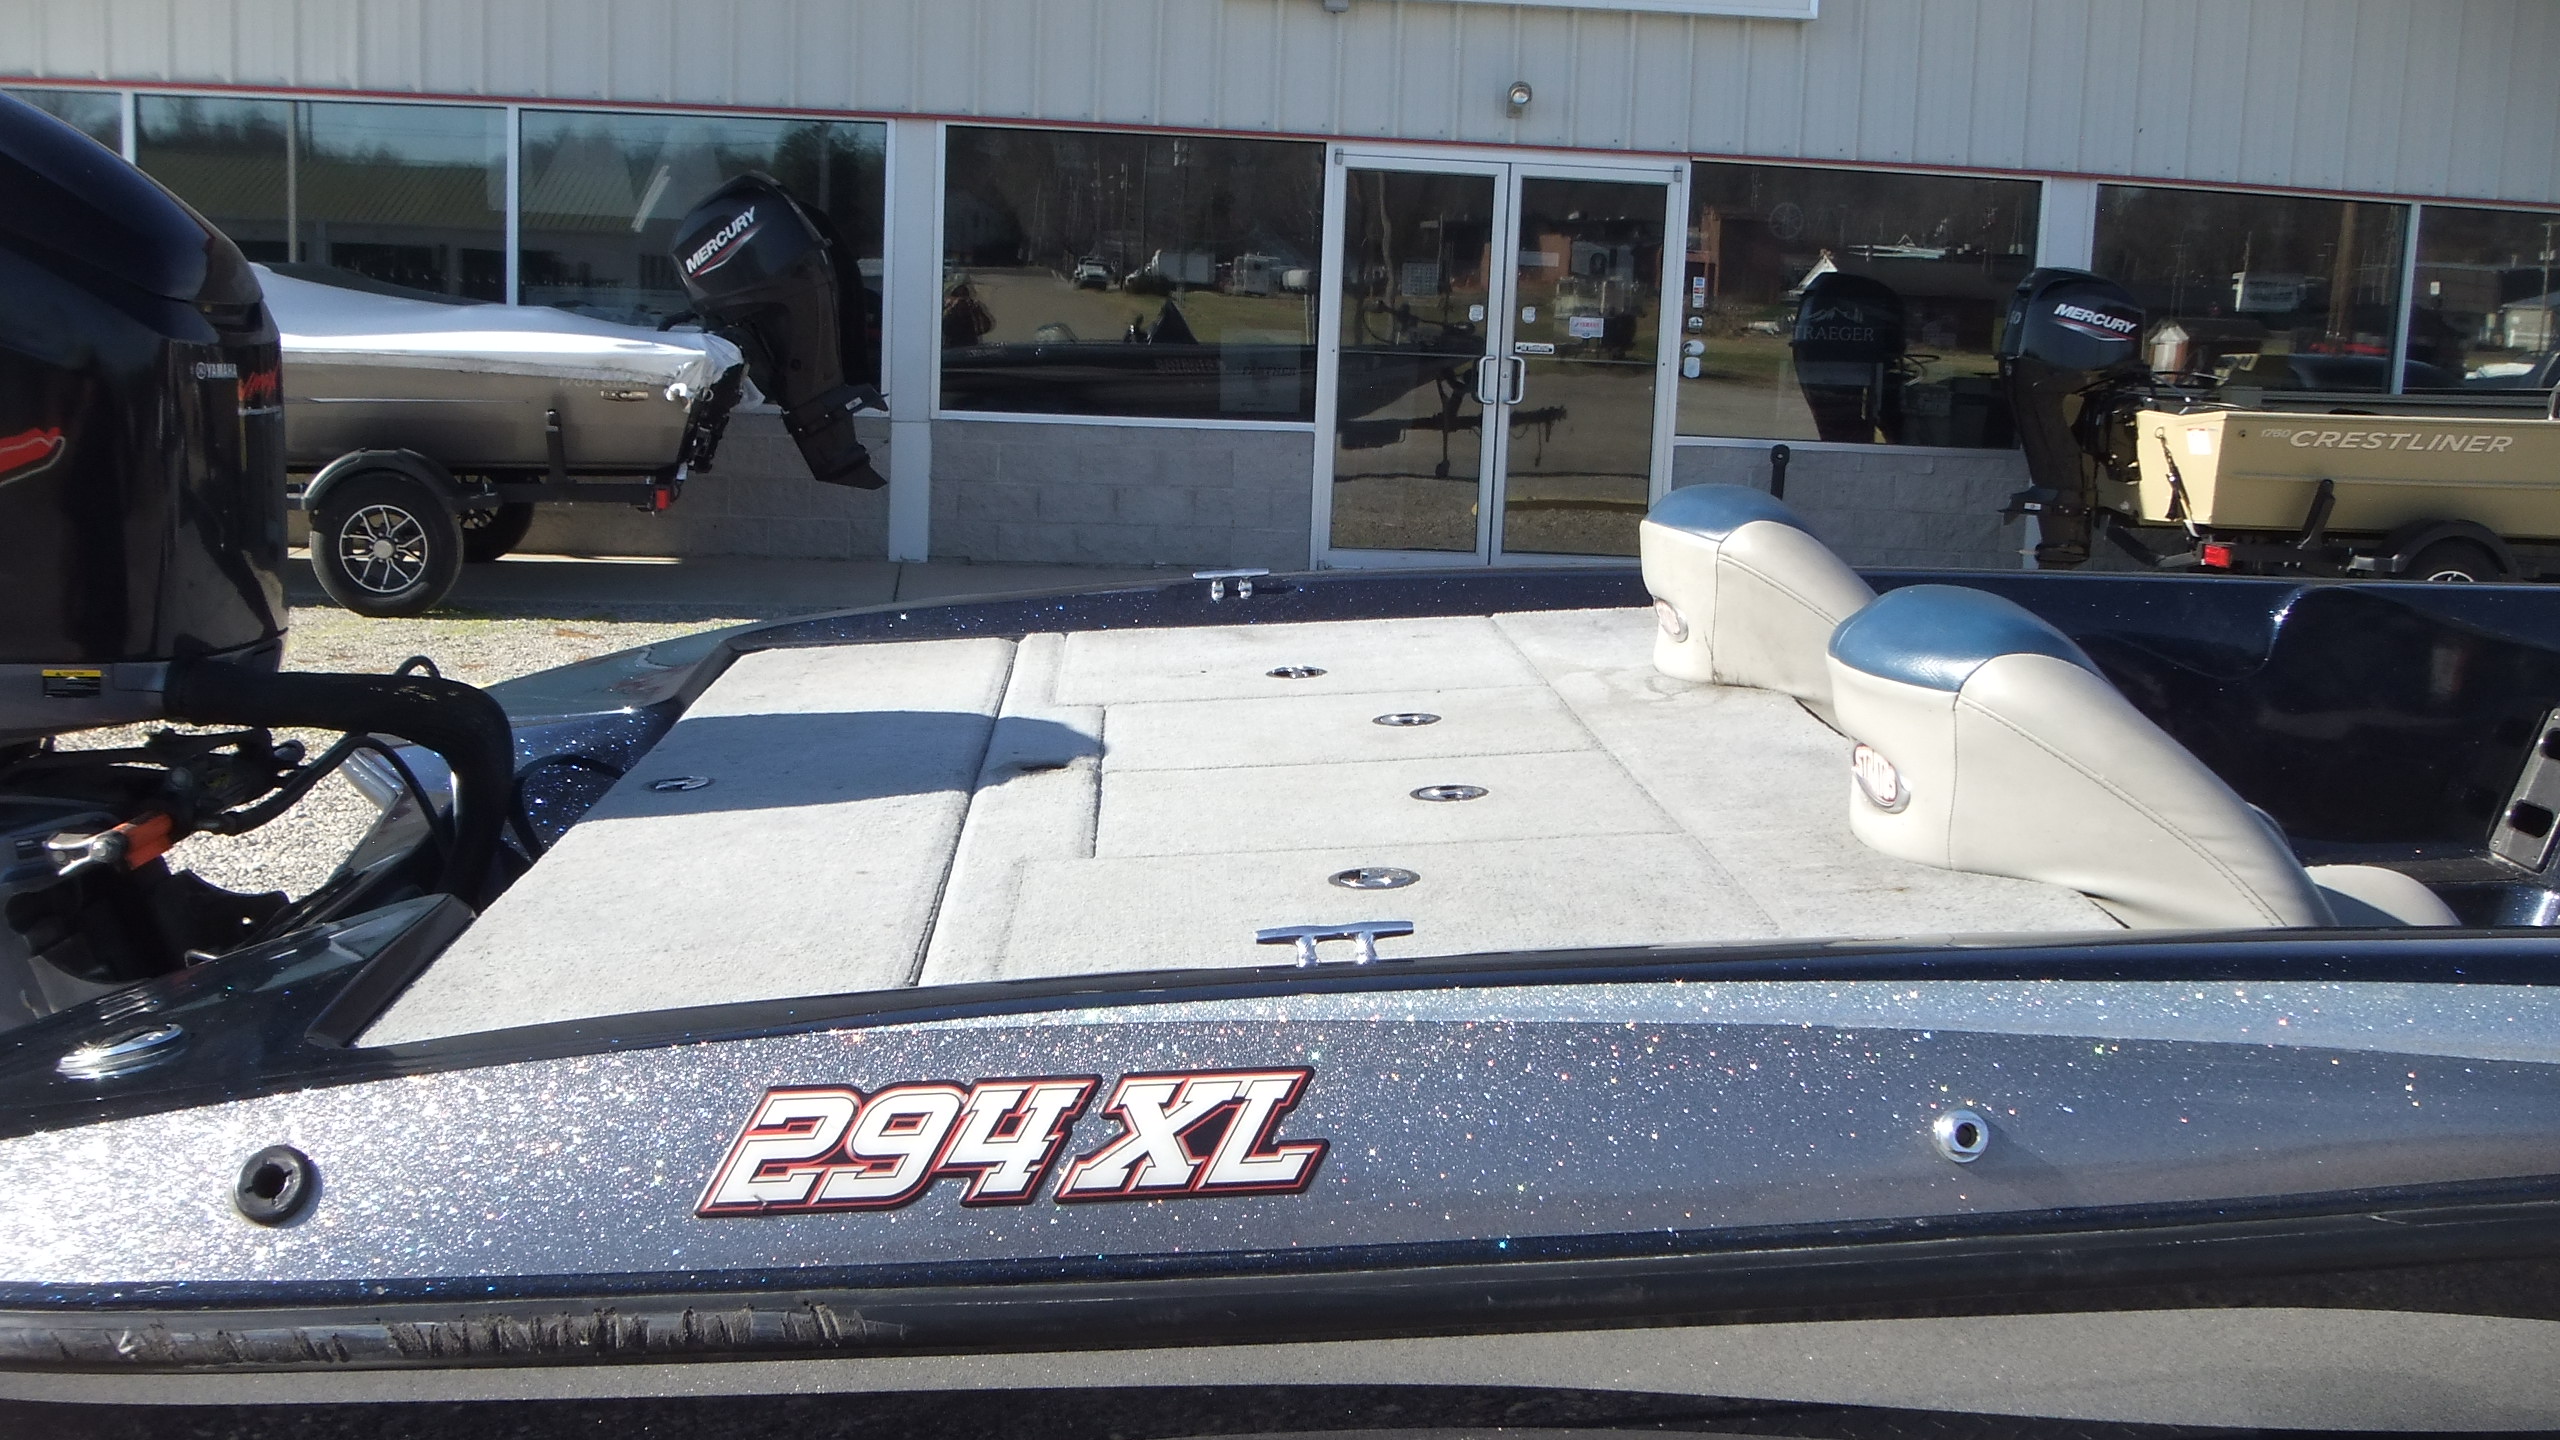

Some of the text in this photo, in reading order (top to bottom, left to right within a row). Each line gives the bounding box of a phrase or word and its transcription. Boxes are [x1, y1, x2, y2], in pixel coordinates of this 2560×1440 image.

[685, 205, 755, 274] MERCURY
[2054, 303, 2137, 334] MERCURY
[1795, 324, 1874, 342] TRAEGER
[207, 363, 238, 379] YAMAHA
[2290, 430, 2513, 453] CRESTLINER
[696, 1066, 1331, 1218] 294 XL
